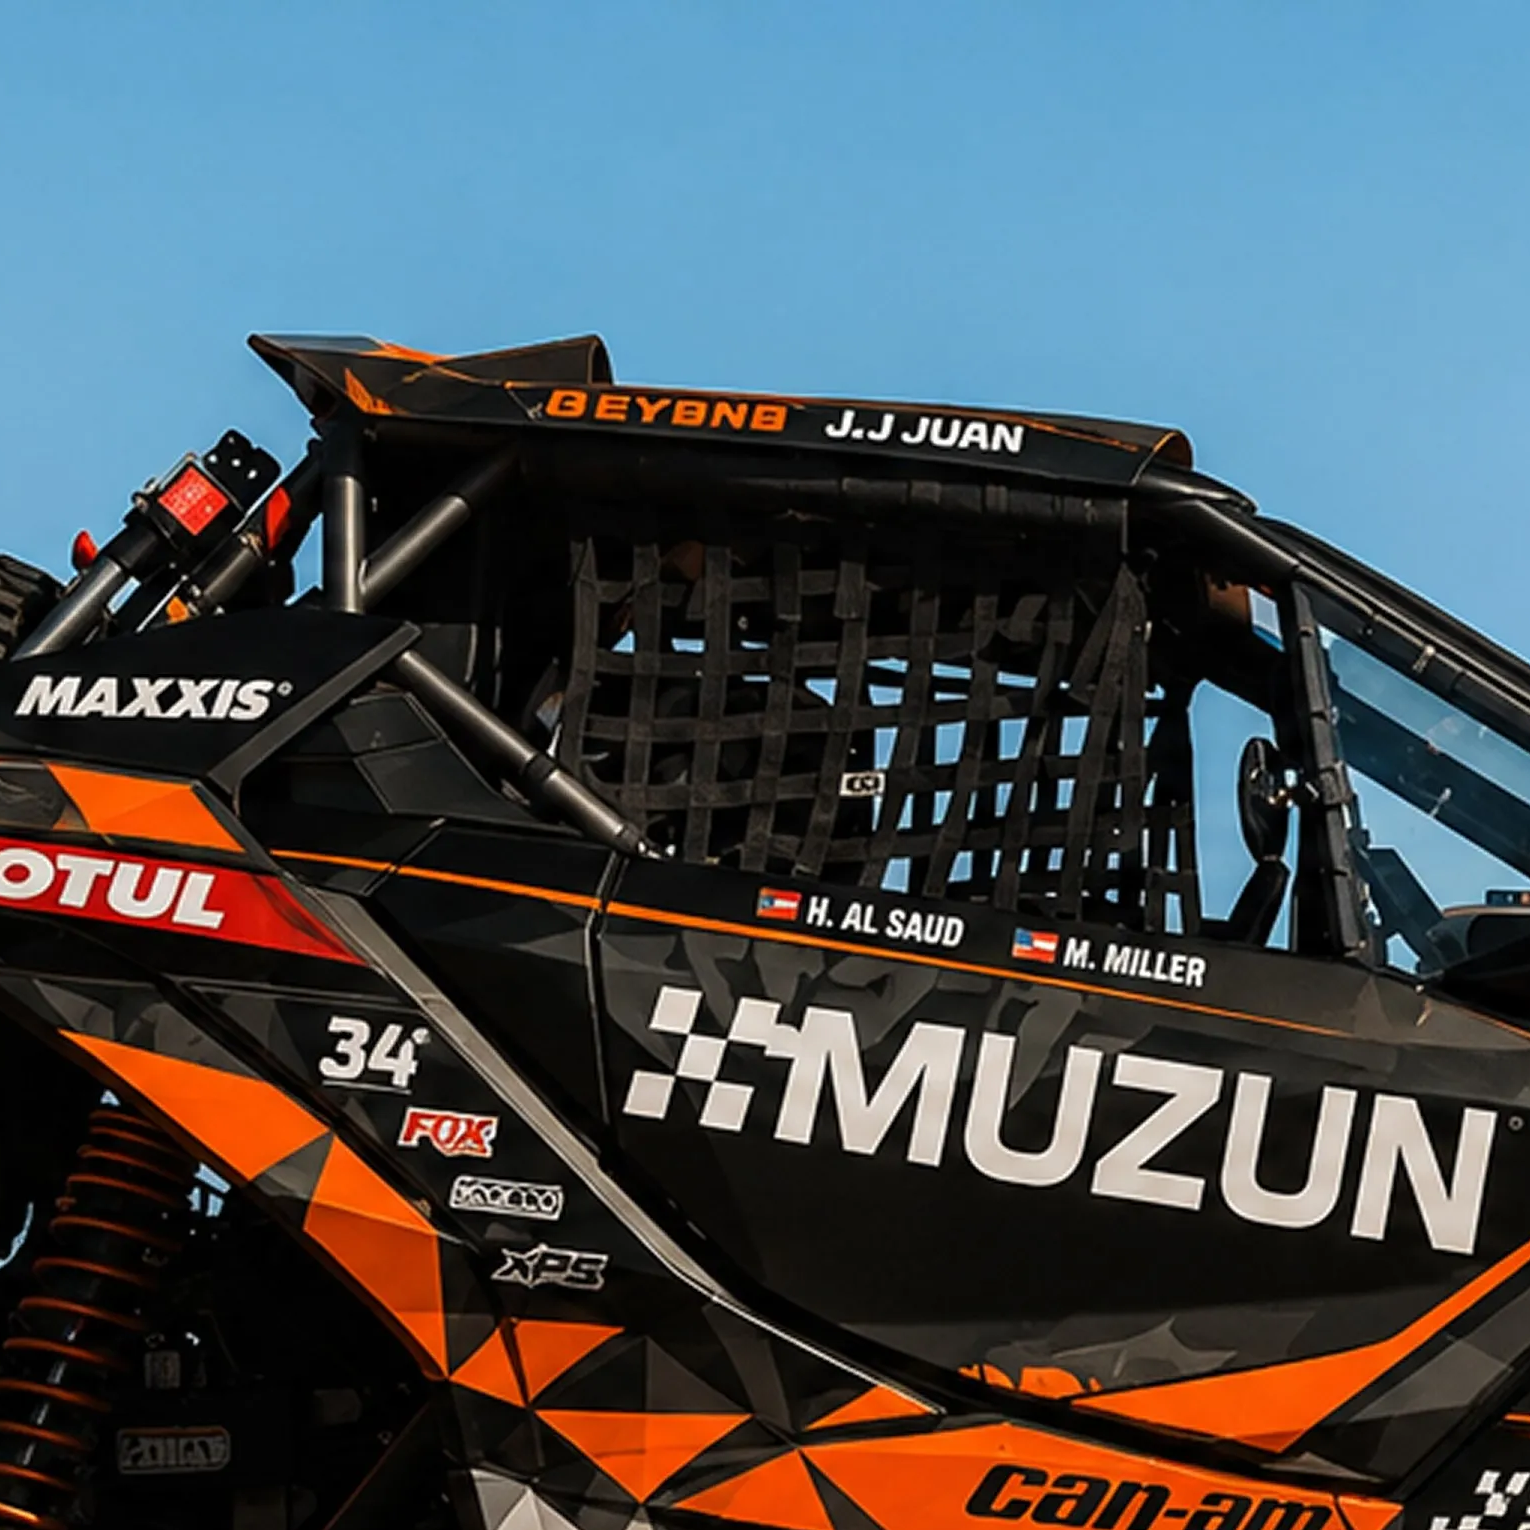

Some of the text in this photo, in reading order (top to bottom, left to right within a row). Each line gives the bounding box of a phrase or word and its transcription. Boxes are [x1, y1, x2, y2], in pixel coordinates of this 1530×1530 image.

[824, 409, 1025, 453] J.J JUAN
[15, 675, 276, 720] MAXXIS
[806, 896, 964, 947] H. AL SAUD
[1062, 937, 1207, 988] M. MILLER
[400, 1109, 496, 1156] FOX
[767, 998, 1498, 1255] MUZUN
[491, 1242, 609, 1290] XPS
